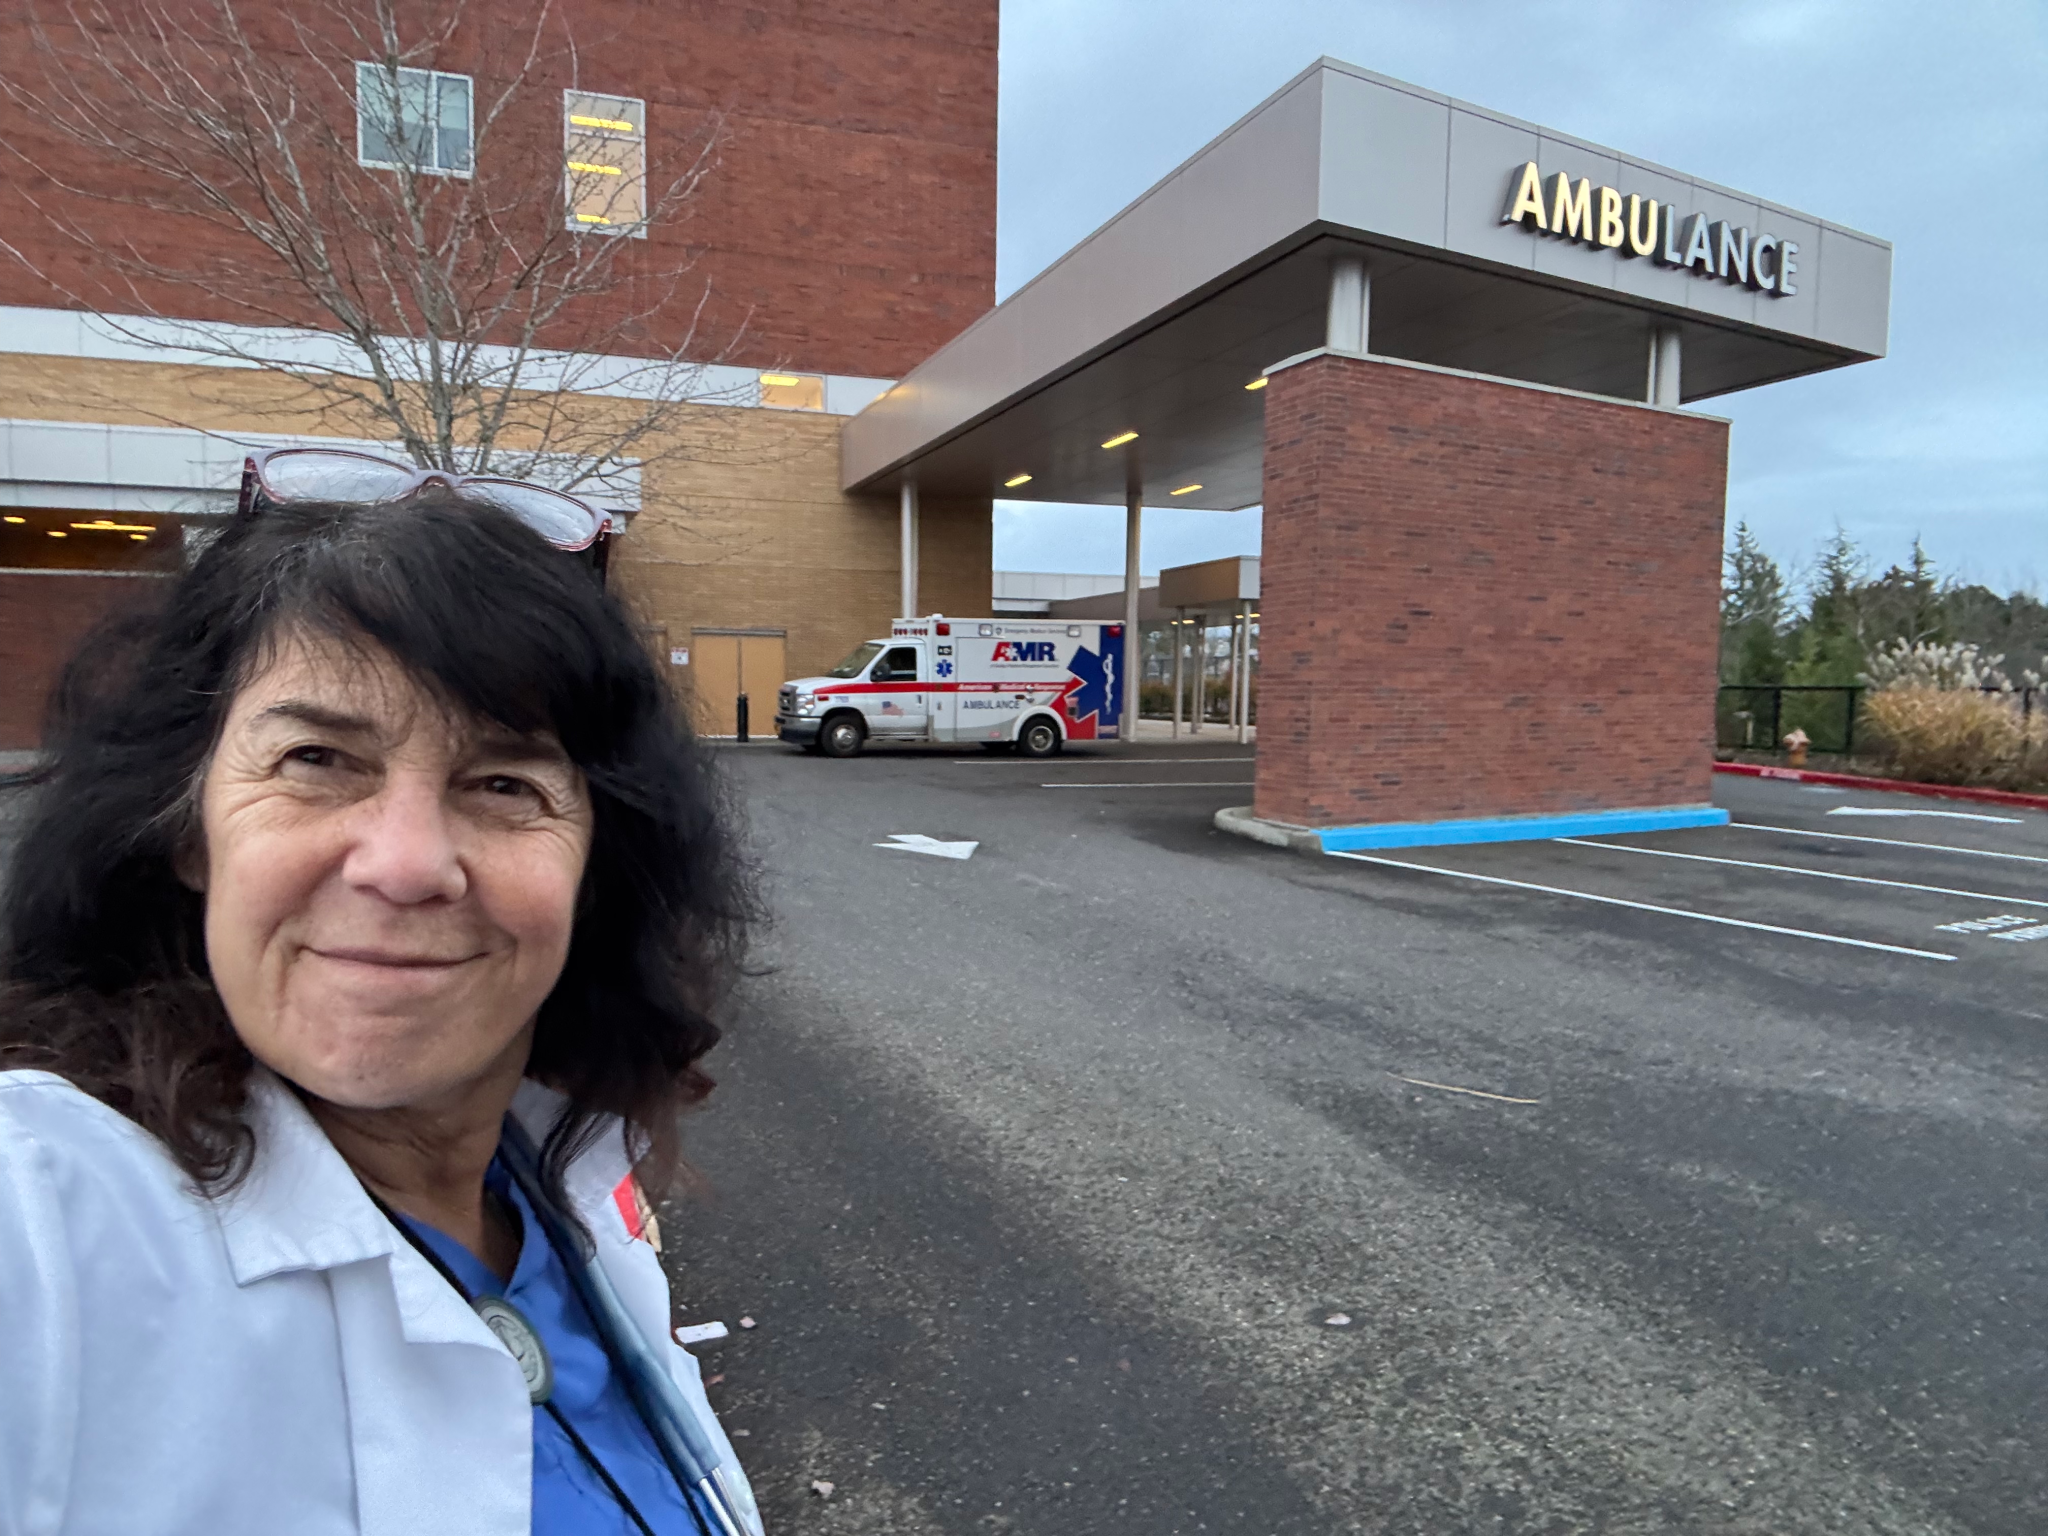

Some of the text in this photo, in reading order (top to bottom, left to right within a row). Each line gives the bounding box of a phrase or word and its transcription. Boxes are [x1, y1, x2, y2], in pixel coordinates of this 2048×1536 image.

[1502, 161, 1799, 296] AMBULANCE
[991, 641, 1056, 661] AMR
[963, 700, 1020, 709] AMBULANCE
